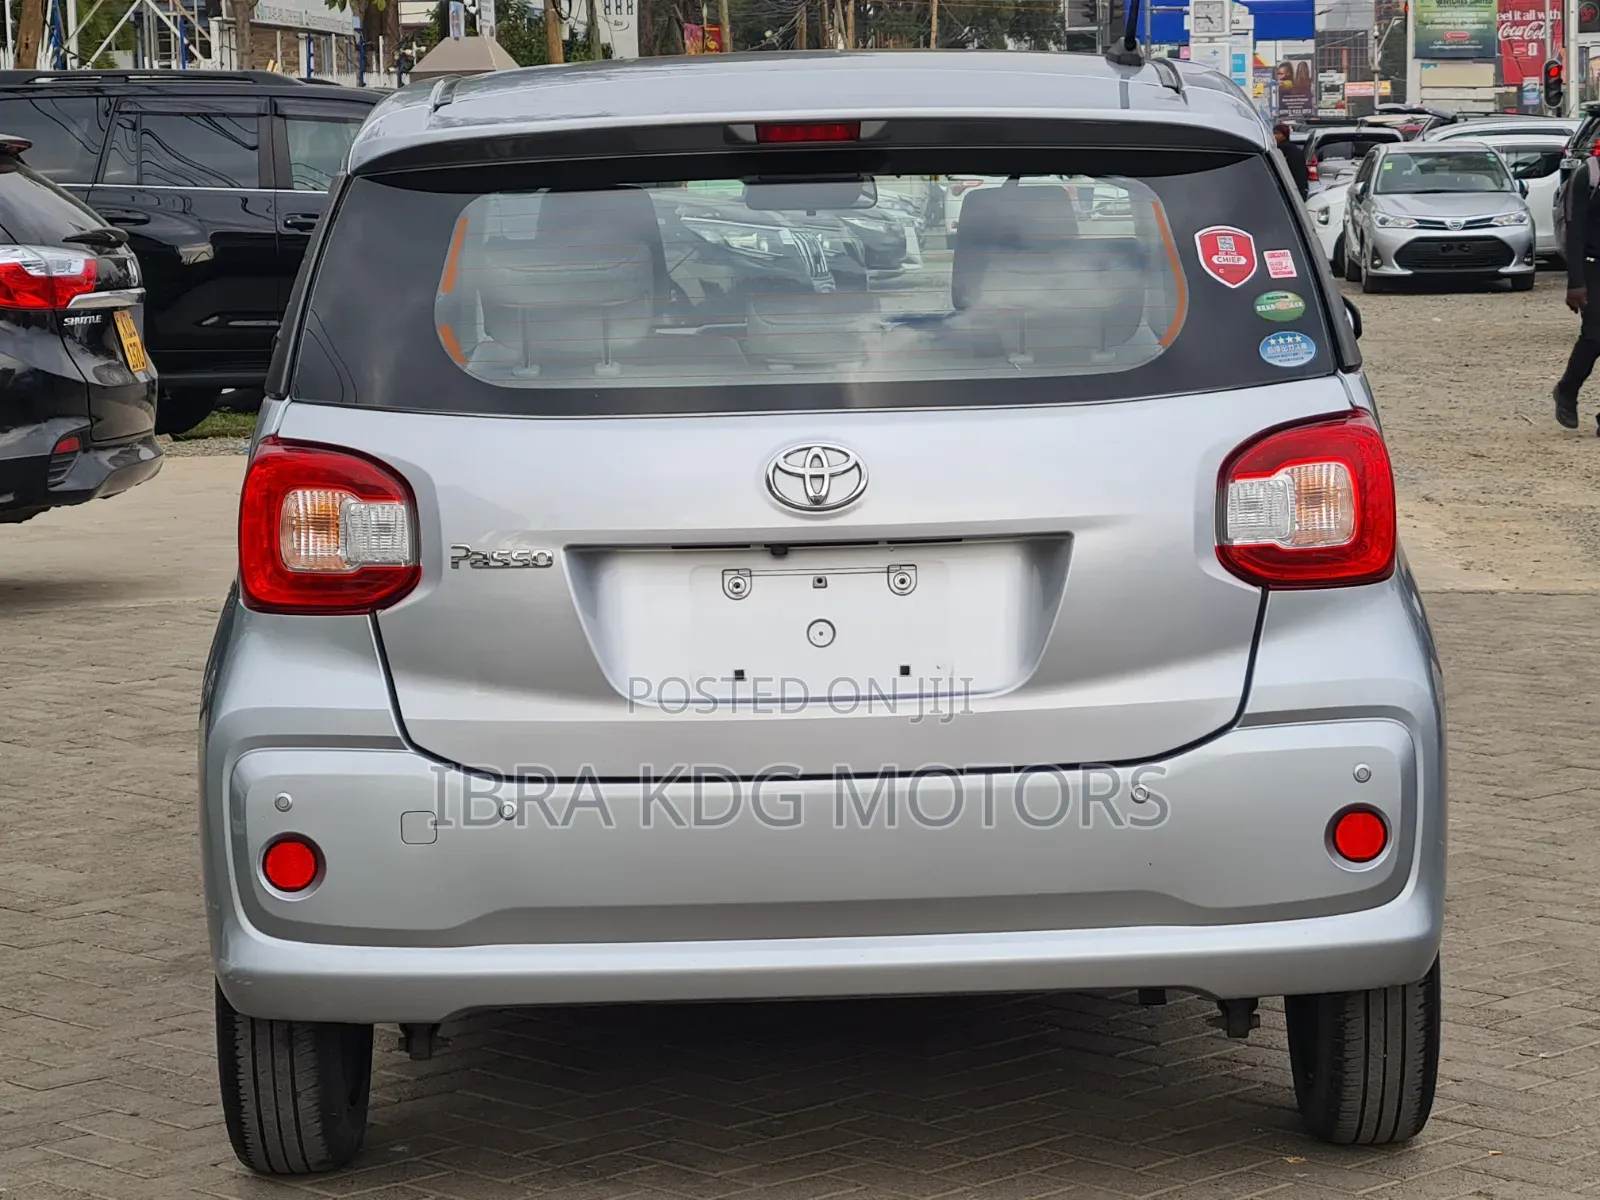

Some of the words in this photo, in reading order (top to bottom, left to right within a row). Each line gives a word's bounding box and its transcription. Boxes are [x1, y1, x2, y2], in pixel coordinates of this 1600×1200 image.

[1522, 9, 1536, 20] all
[1537, 9, 1561, 20] wth
[1498, 21, 1554, 40] Coca-Col
[63, 315, 102, 326] SHUTTLE
